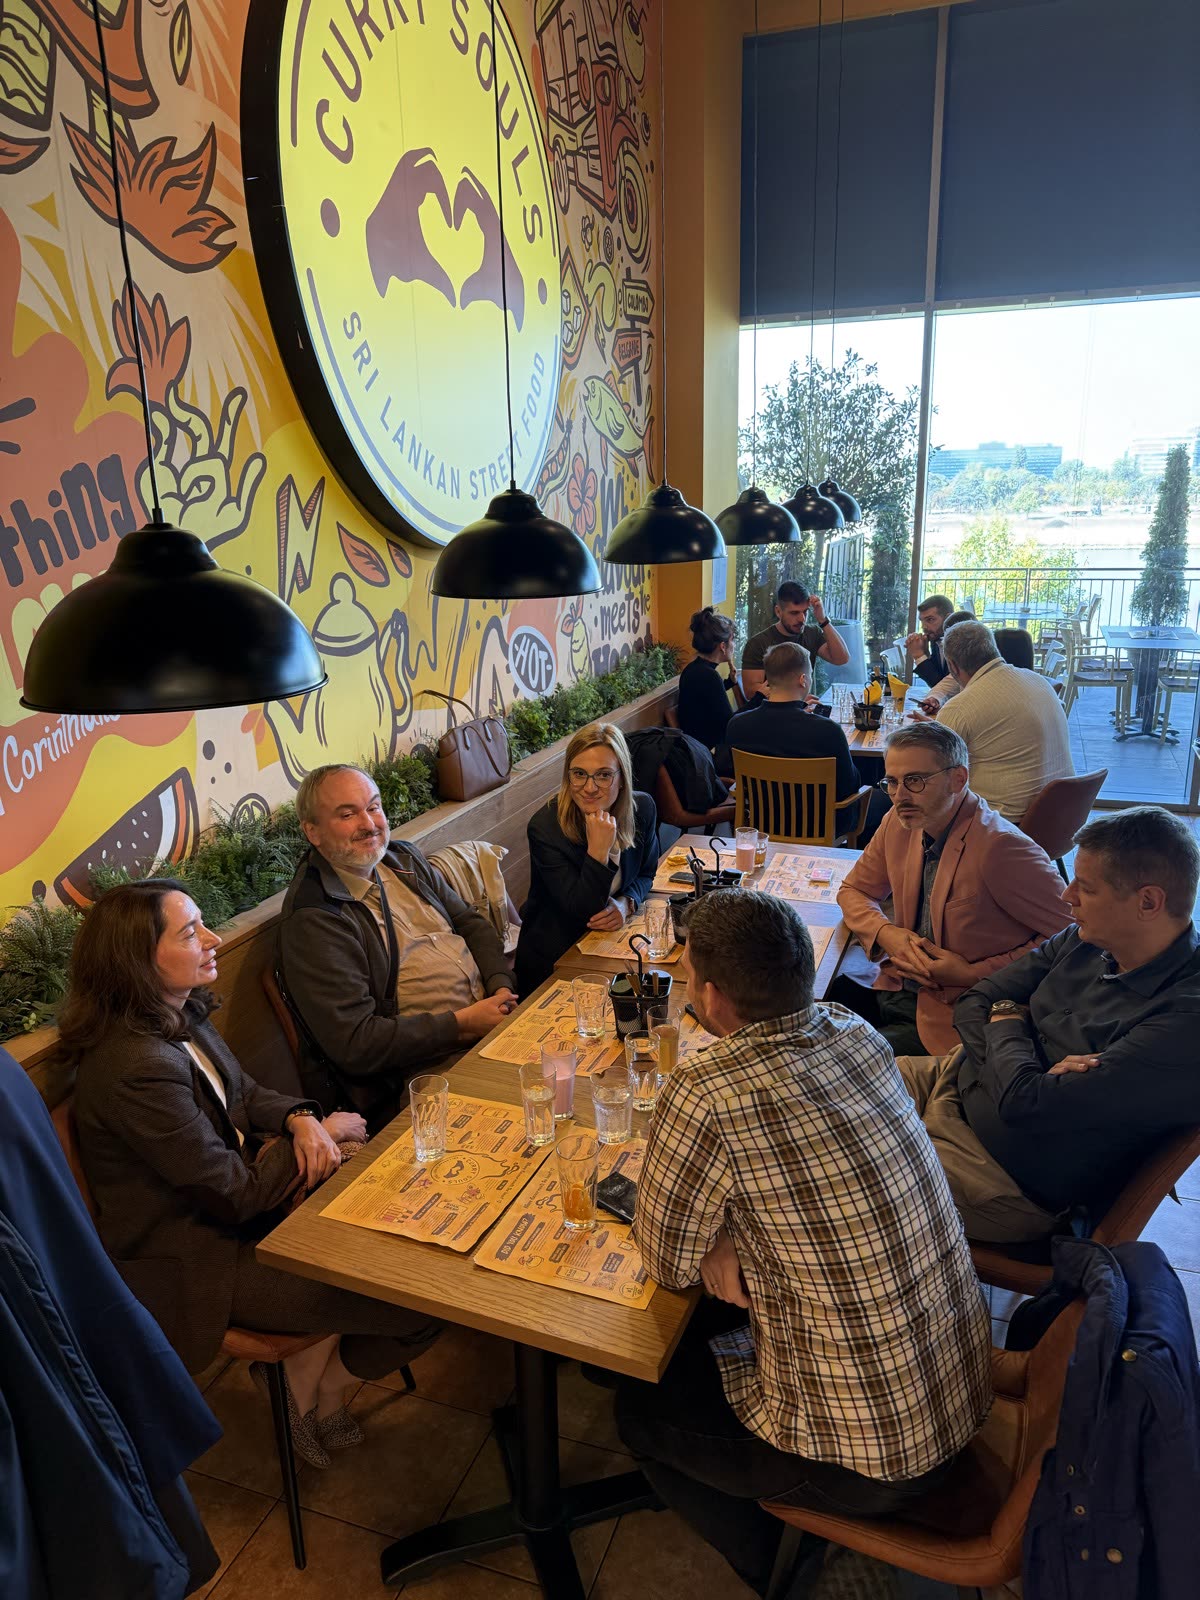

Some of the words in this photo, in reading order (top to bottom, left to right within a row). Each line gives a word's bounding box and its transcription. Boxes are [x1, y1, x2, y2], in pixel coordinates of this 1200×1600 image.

[450, 0, 543, 244] SOULS
[618, 340, 640, 361] BELGRADE
[342, 311, 379, 392] SRI
[379, 395, 461, 499] LANKAN
[469, 430, 522, 500] STREET
[521, 352, 545, 438] FOOD
[600, 587, 640, 641] meets
[514, 634, 549, 690] HOT
[3, 713, 120, 793] Corinthia
